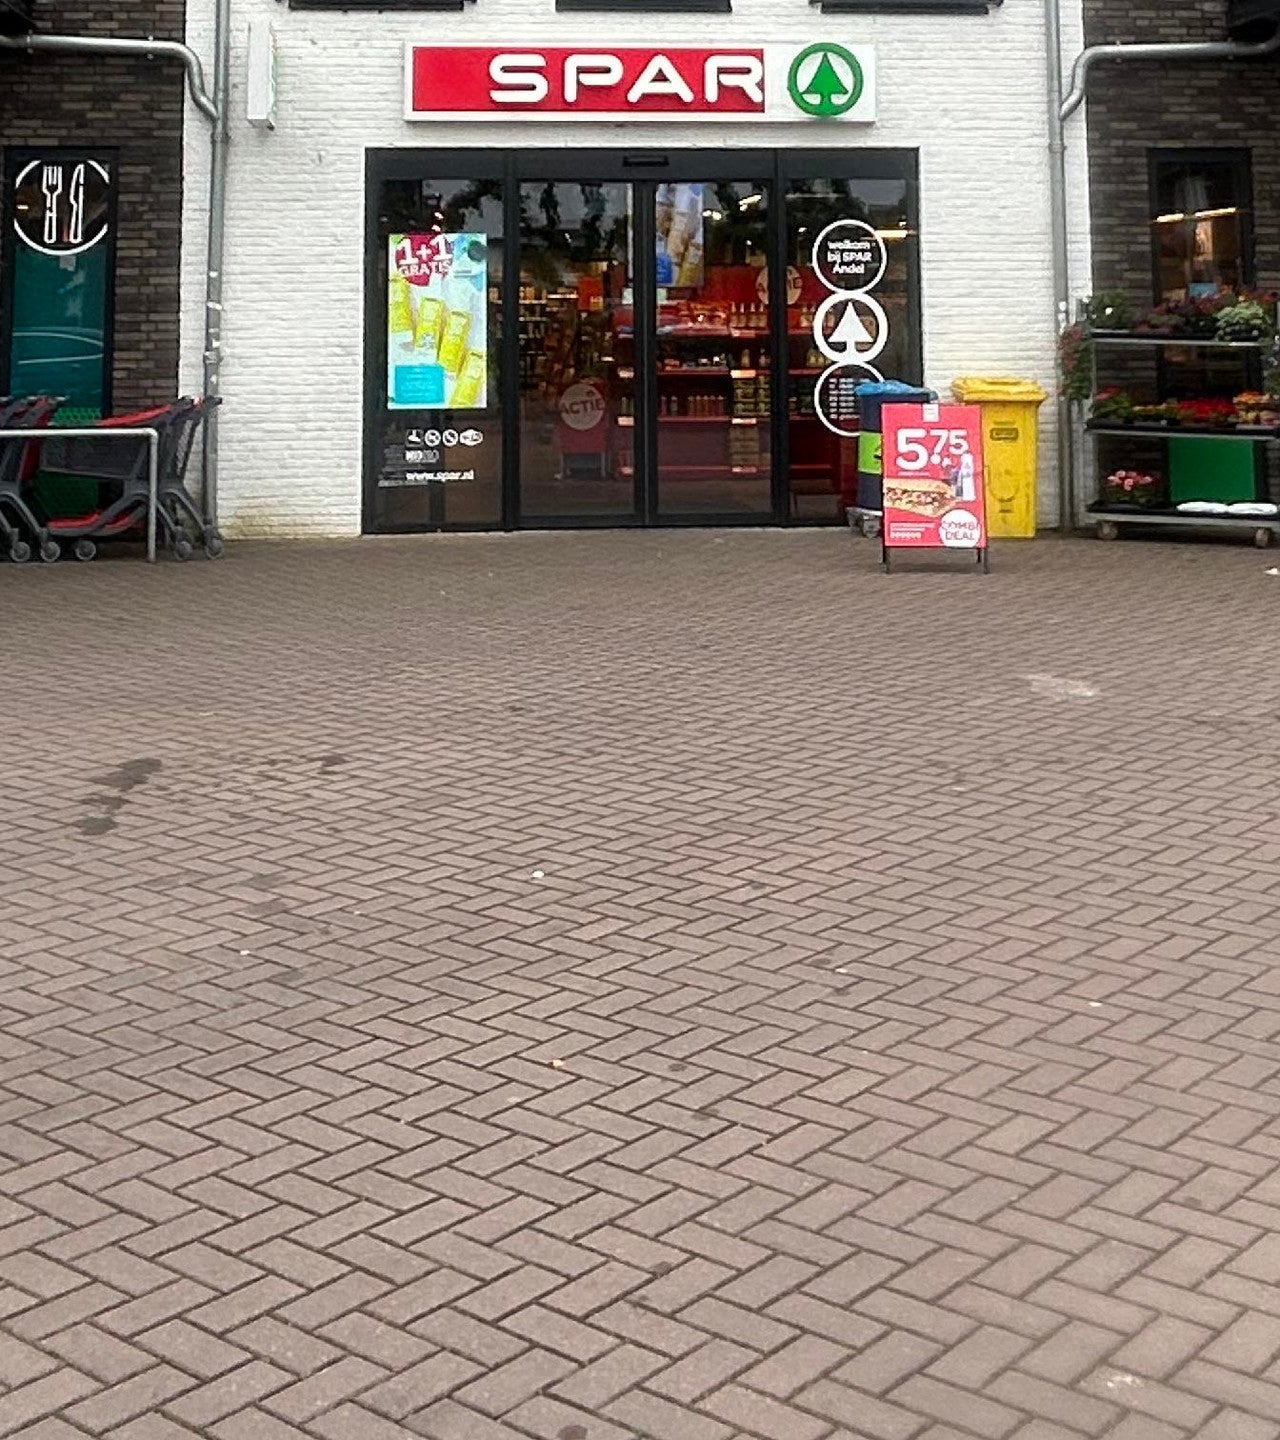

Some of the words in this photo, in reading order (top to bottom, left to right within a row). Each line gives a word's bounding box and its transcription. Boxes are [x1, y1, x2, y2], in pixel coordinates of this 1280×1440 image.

[489, 53, 764, 103] SPAR
[395, 236, 453, 265] 1+1
[843, 251, 872, 262] SPAR
[399, 260, 451, 277] GRATIS
[560, 398, 605, 415] ACTIE
